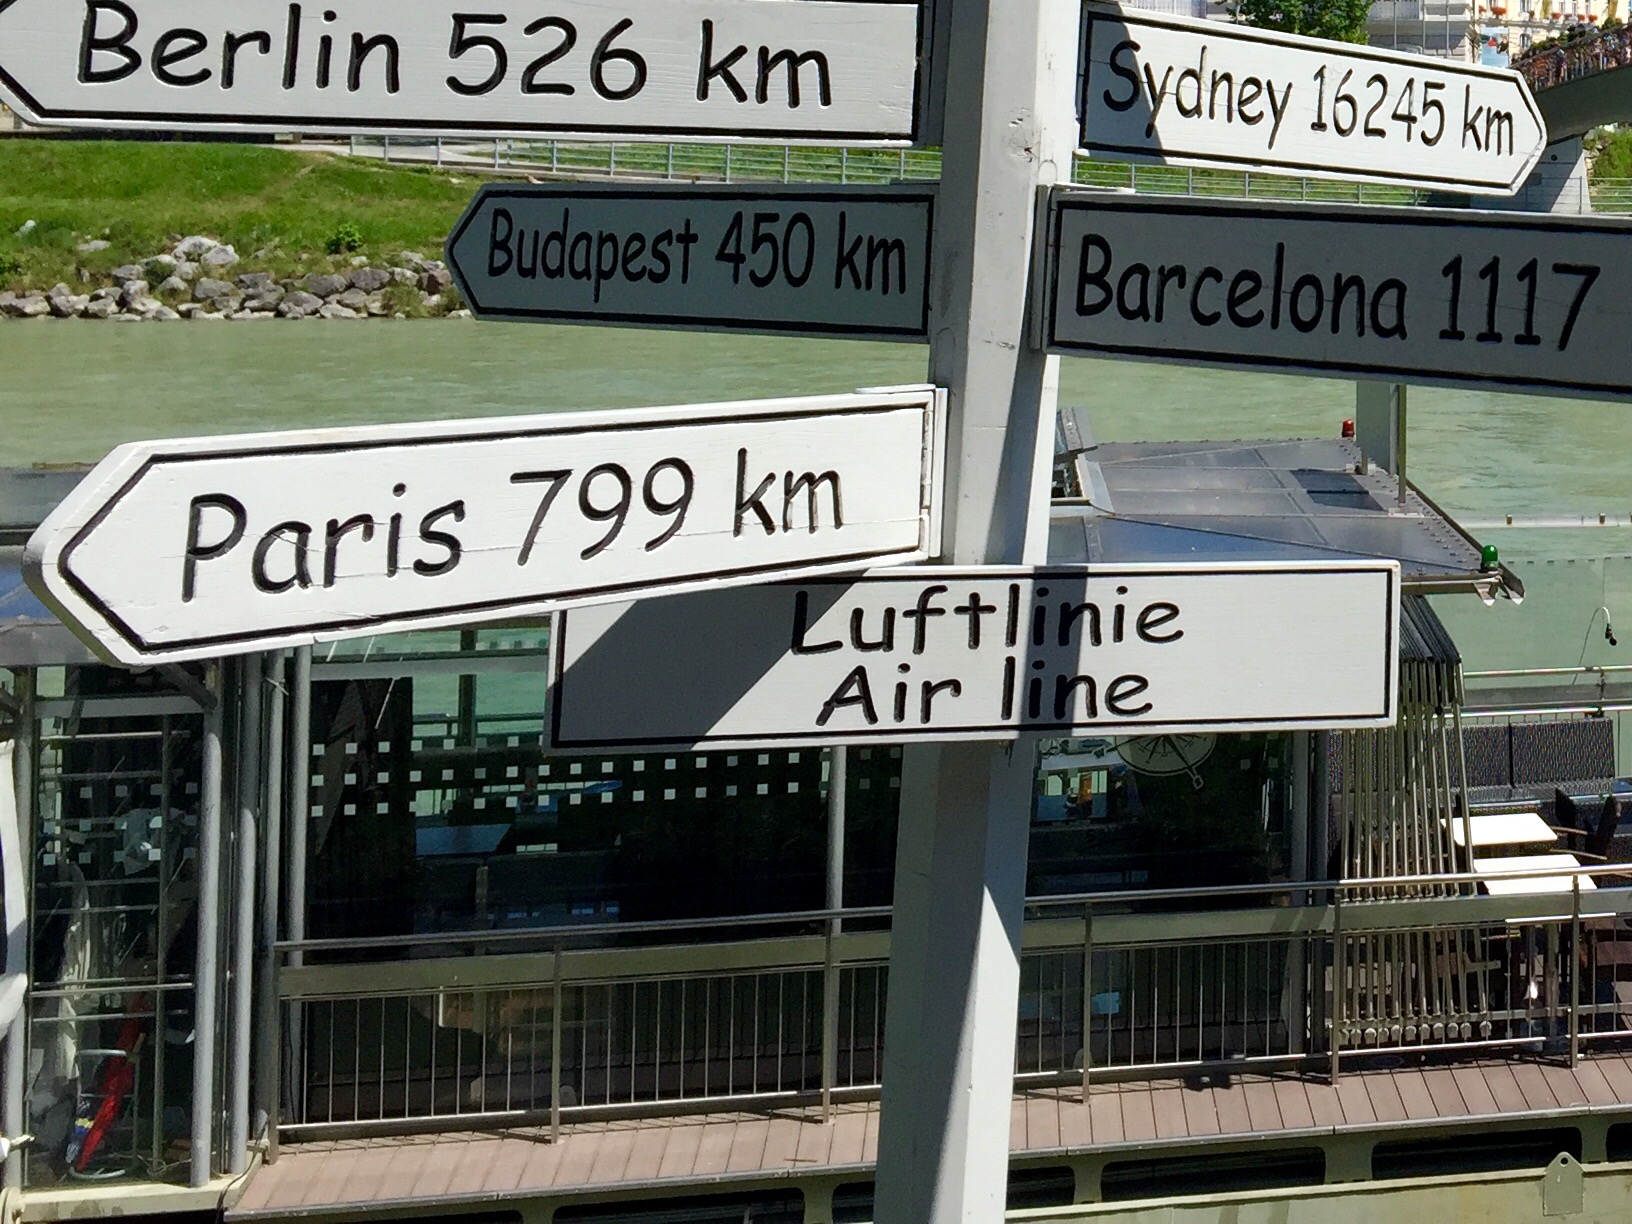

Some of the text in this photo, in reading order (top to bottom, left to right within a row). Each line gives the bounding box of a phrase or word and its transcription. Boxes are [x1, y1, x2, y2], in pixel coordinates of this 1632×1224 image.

[445, 12, 648, 102] 526
[696, 18, 832, 109] km
[1103, 39, 1515, 156] Sydney 16245 km
[486, 206, 907, 305] Budapest 450 km
[1075, 233, 1409, 342] Barcelona
[1437, 254, 1602, 353] 1117
[182, 447, 844, 603] Paris 799 km
[790, 583, 1185, 655] Luftlinie
[816, 656, 1154, 726] Air line
